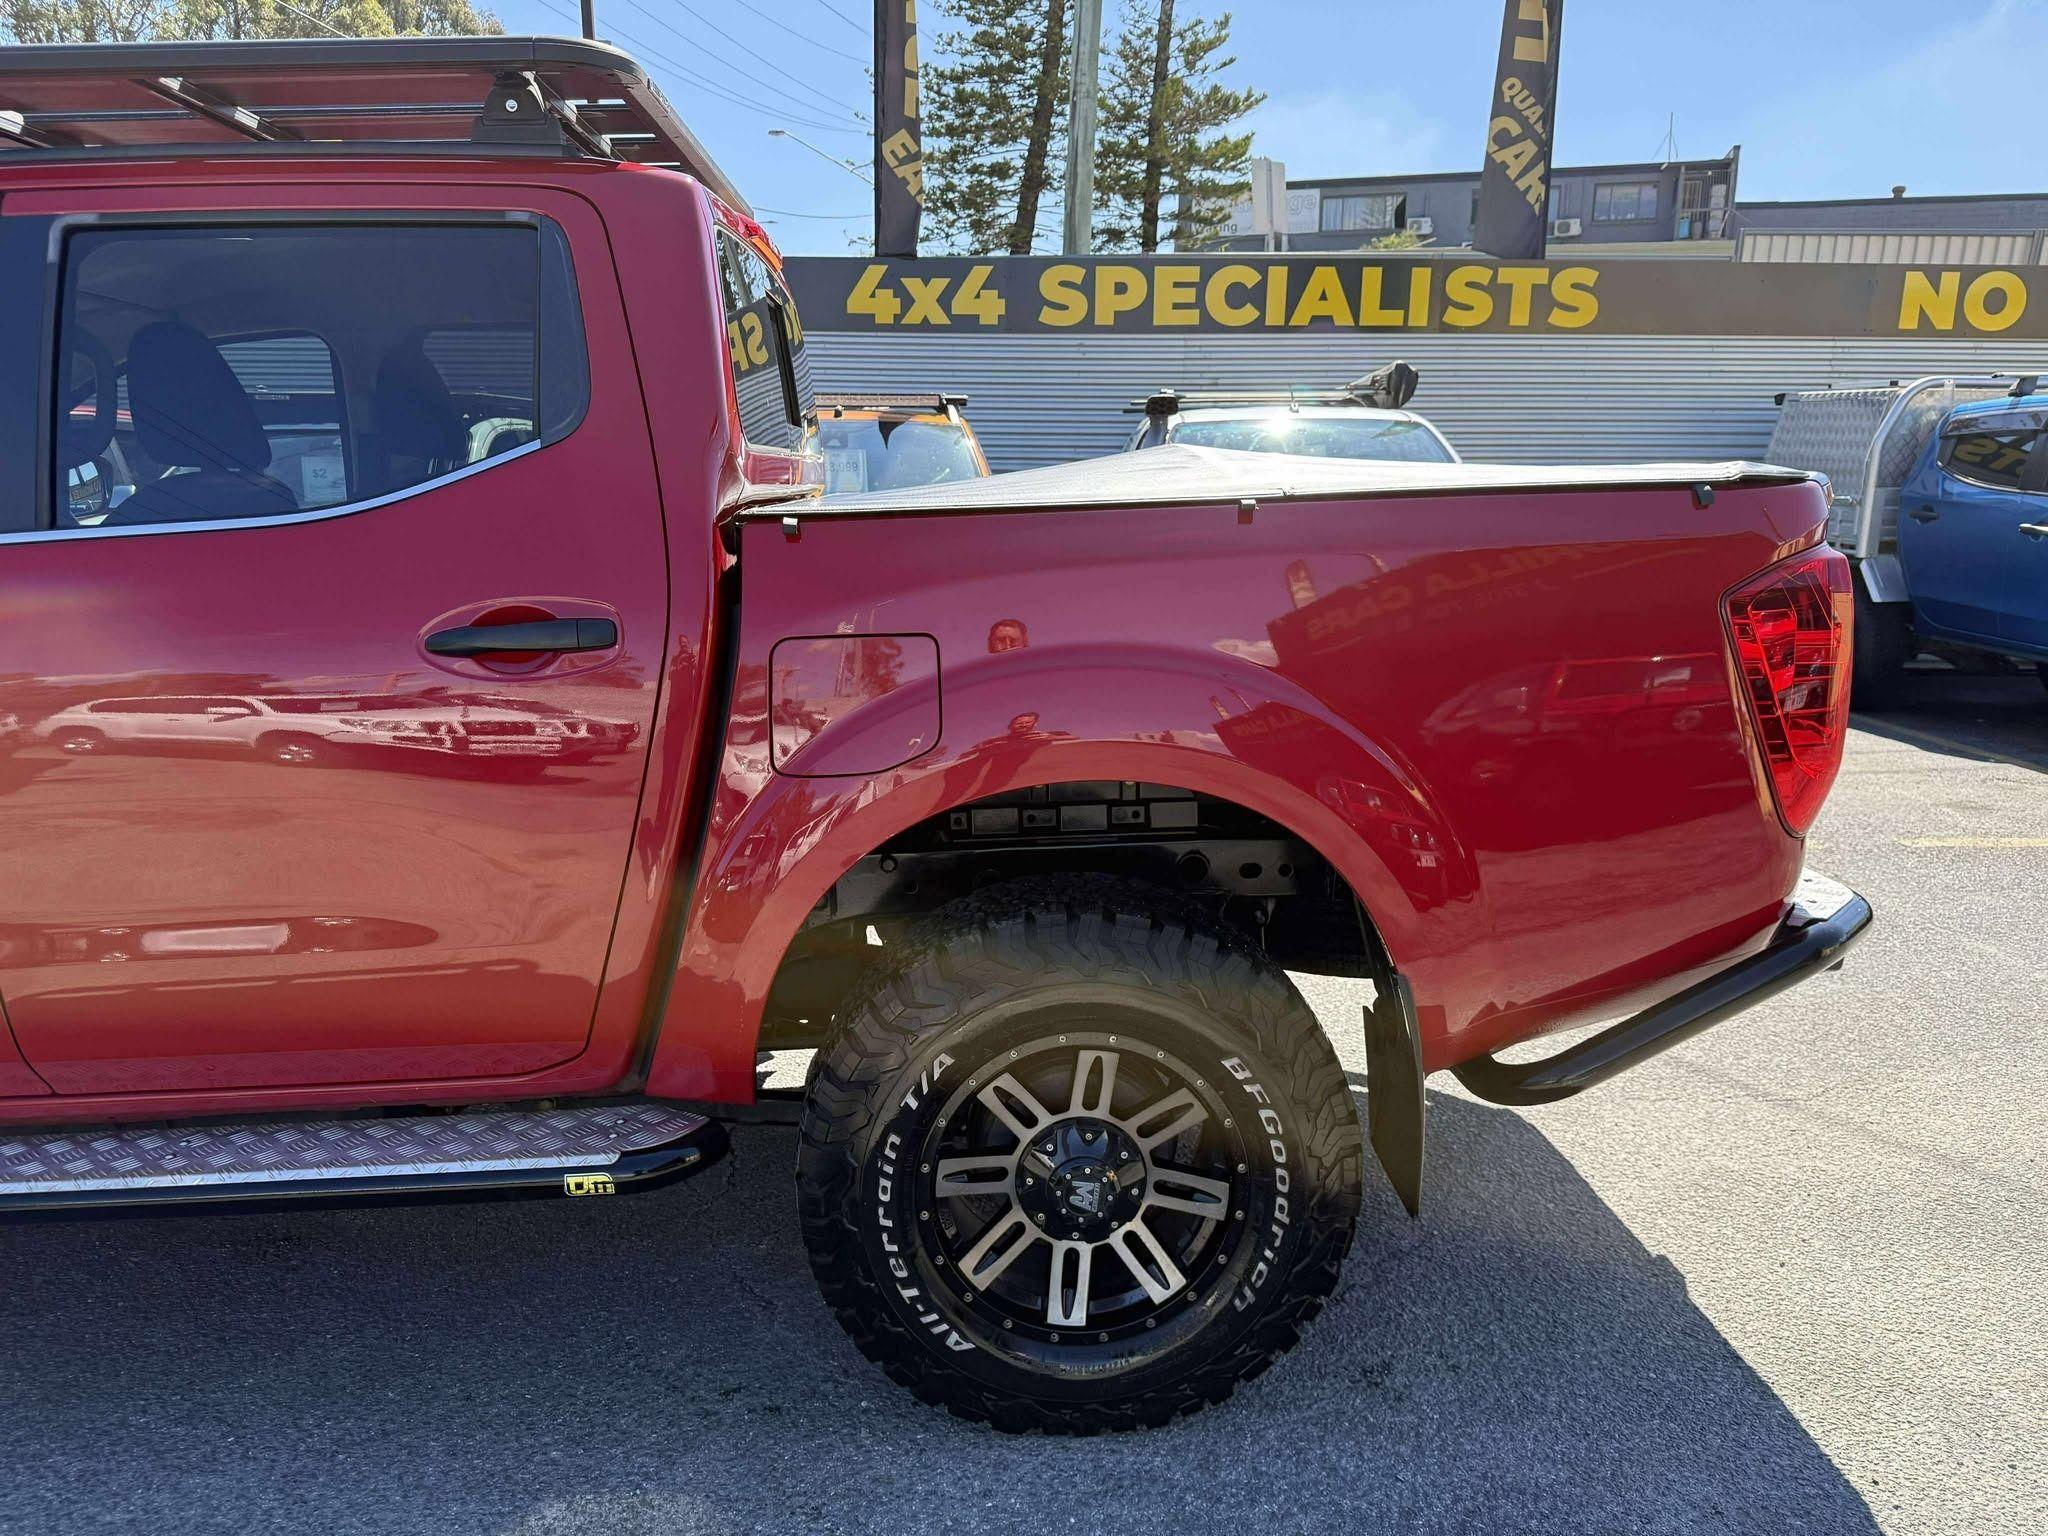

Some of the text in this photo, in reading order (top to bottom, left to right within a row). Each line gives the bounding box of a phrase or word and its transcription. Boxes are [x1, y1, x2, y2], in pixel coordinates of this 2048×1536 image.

[847, 264, 1006, 325] 4x4
[1038, 264, 1601, 329] SPECIALISTS
[1897, 270, 2028, 332] NO
[1220, 1056, 1291, 1313] BFGoodrich
